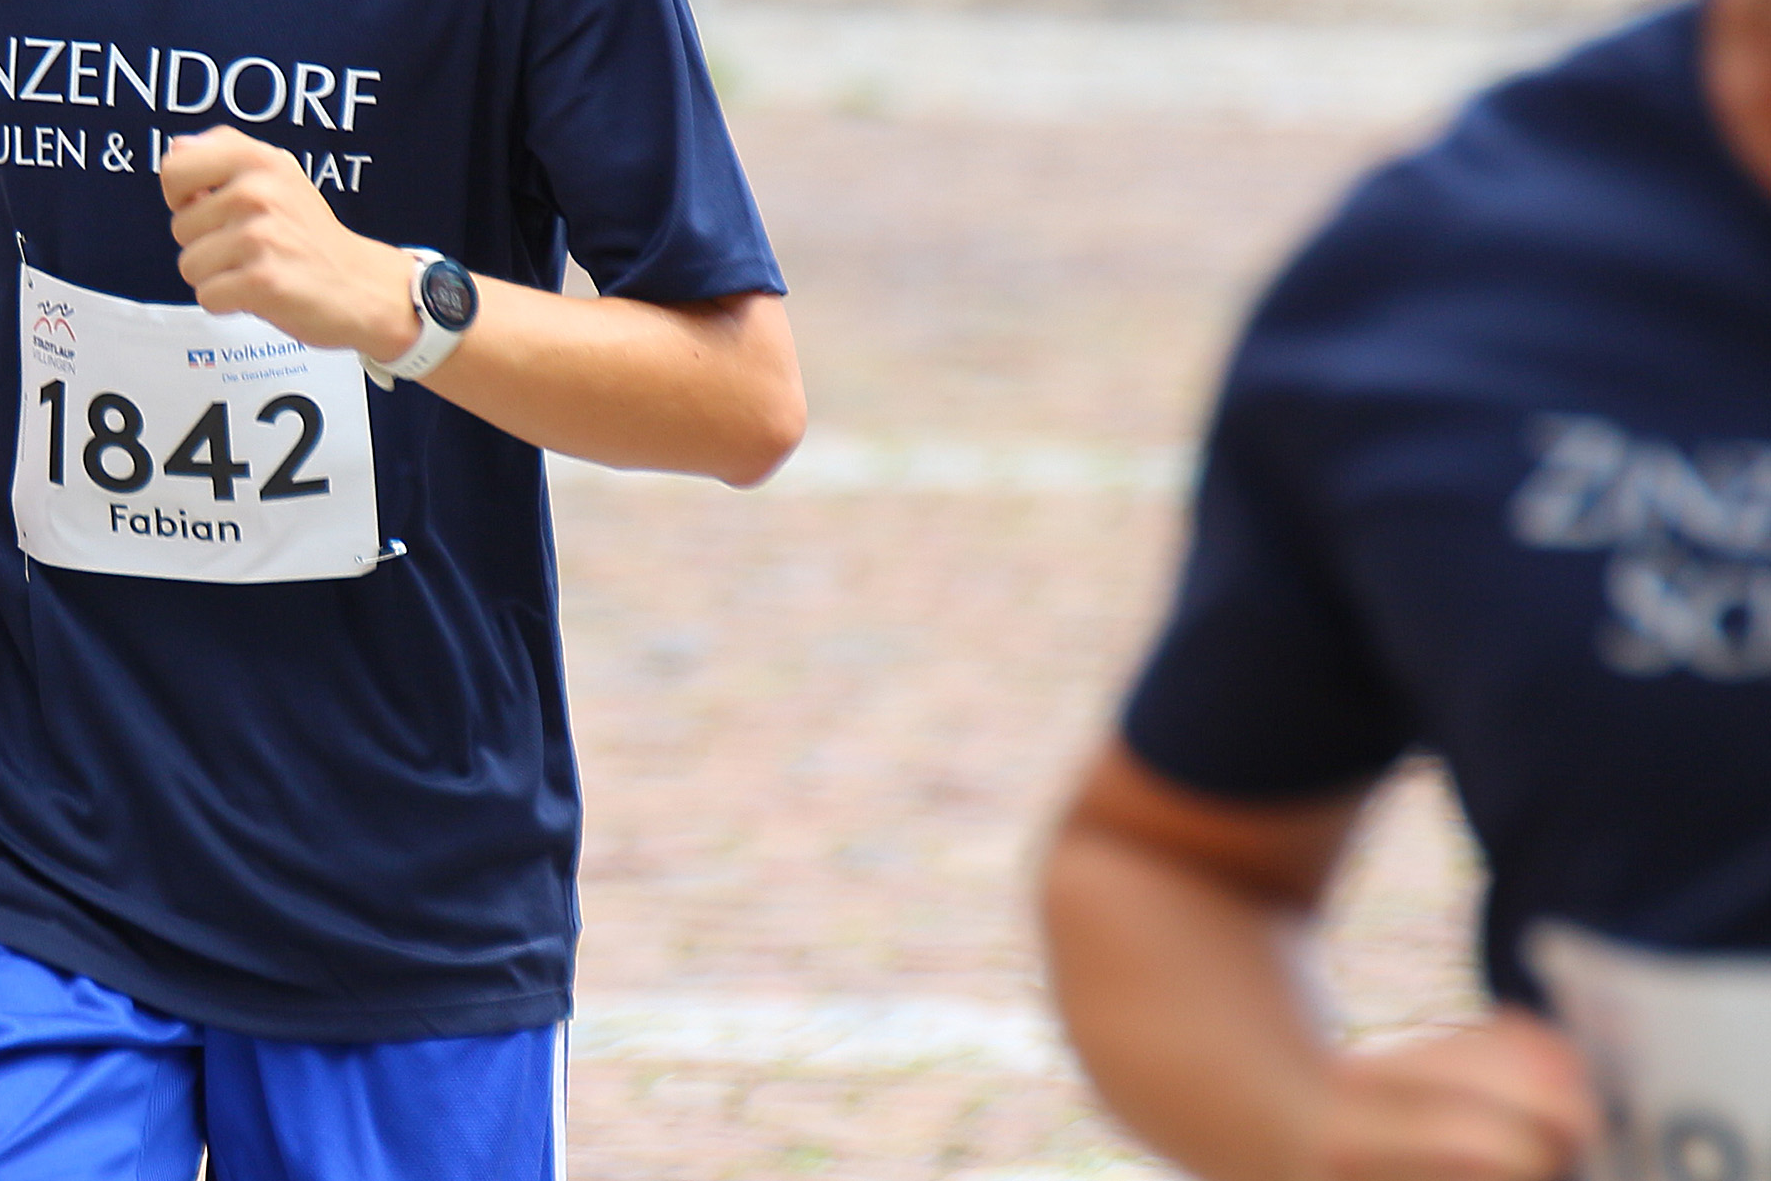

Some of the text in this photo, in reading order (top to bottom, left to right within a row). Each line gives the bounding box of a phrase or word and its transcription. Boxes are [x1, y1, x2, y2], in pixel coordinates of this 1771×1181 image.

[101, 131, 135, 174] &
[221, 340, 307, 363] Volksbank
[39, 378, 331, 502] 1842
[109, 503, 242, 543] Fabian
